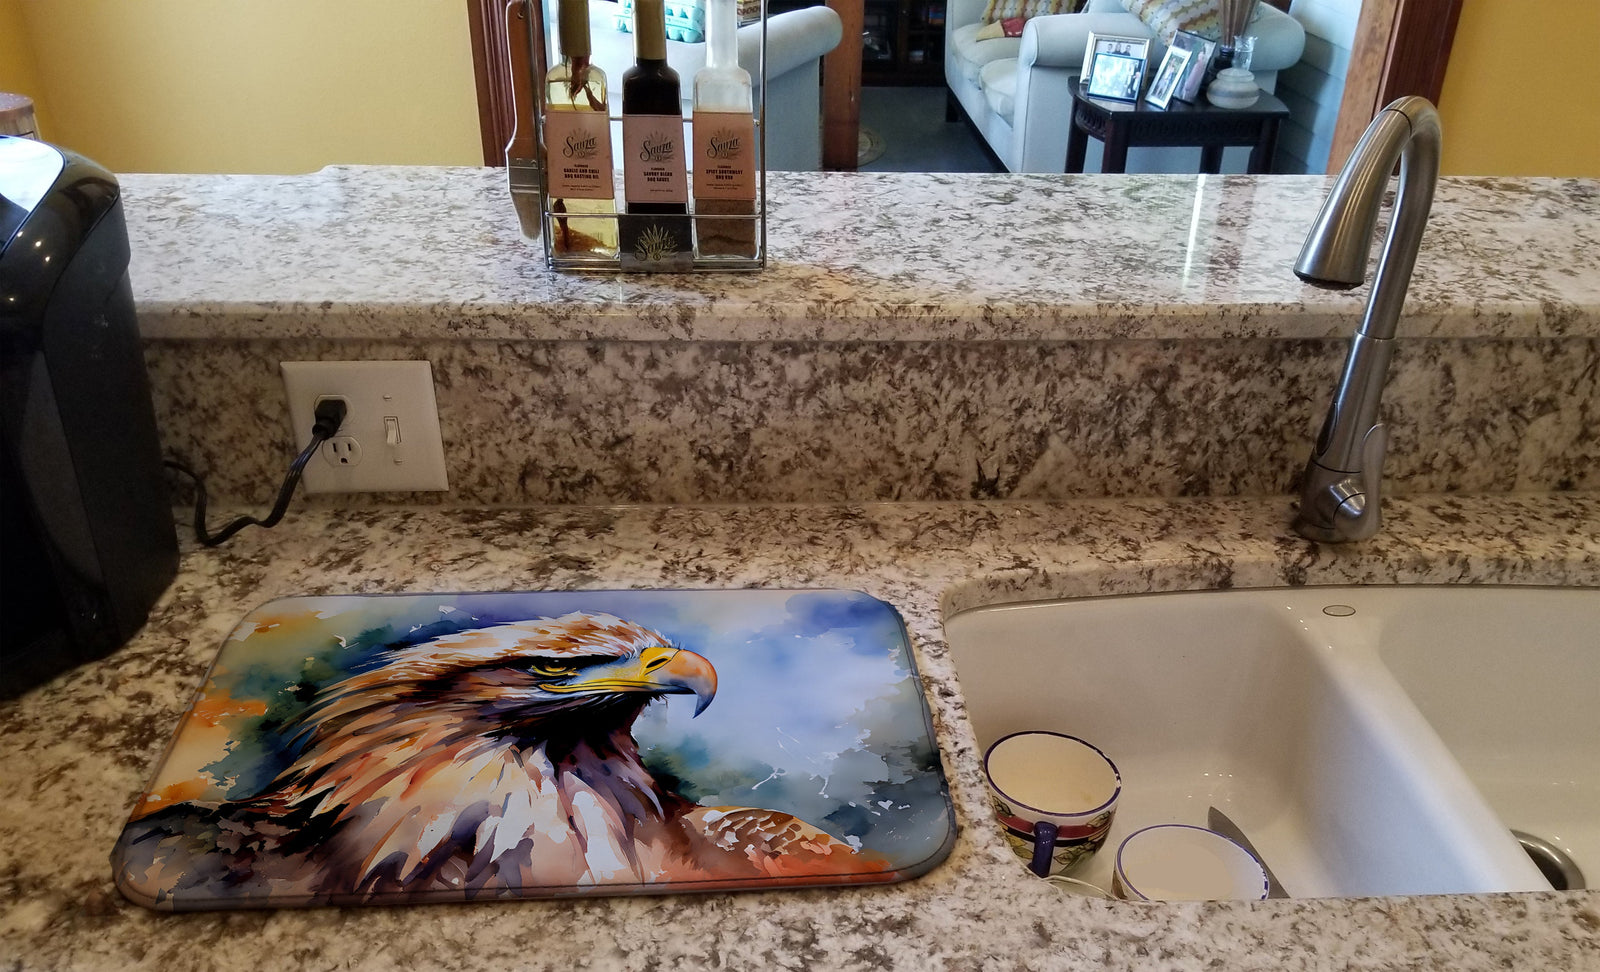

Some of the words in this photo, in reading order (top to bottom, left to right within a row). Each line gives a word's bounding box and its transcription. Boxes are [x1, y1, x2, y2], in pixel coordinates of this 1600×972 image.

[563, 136, 597, 158] Sauza
[640, 140, 673, 161] Sauza
[707, 136, 739, 158] Sauza
